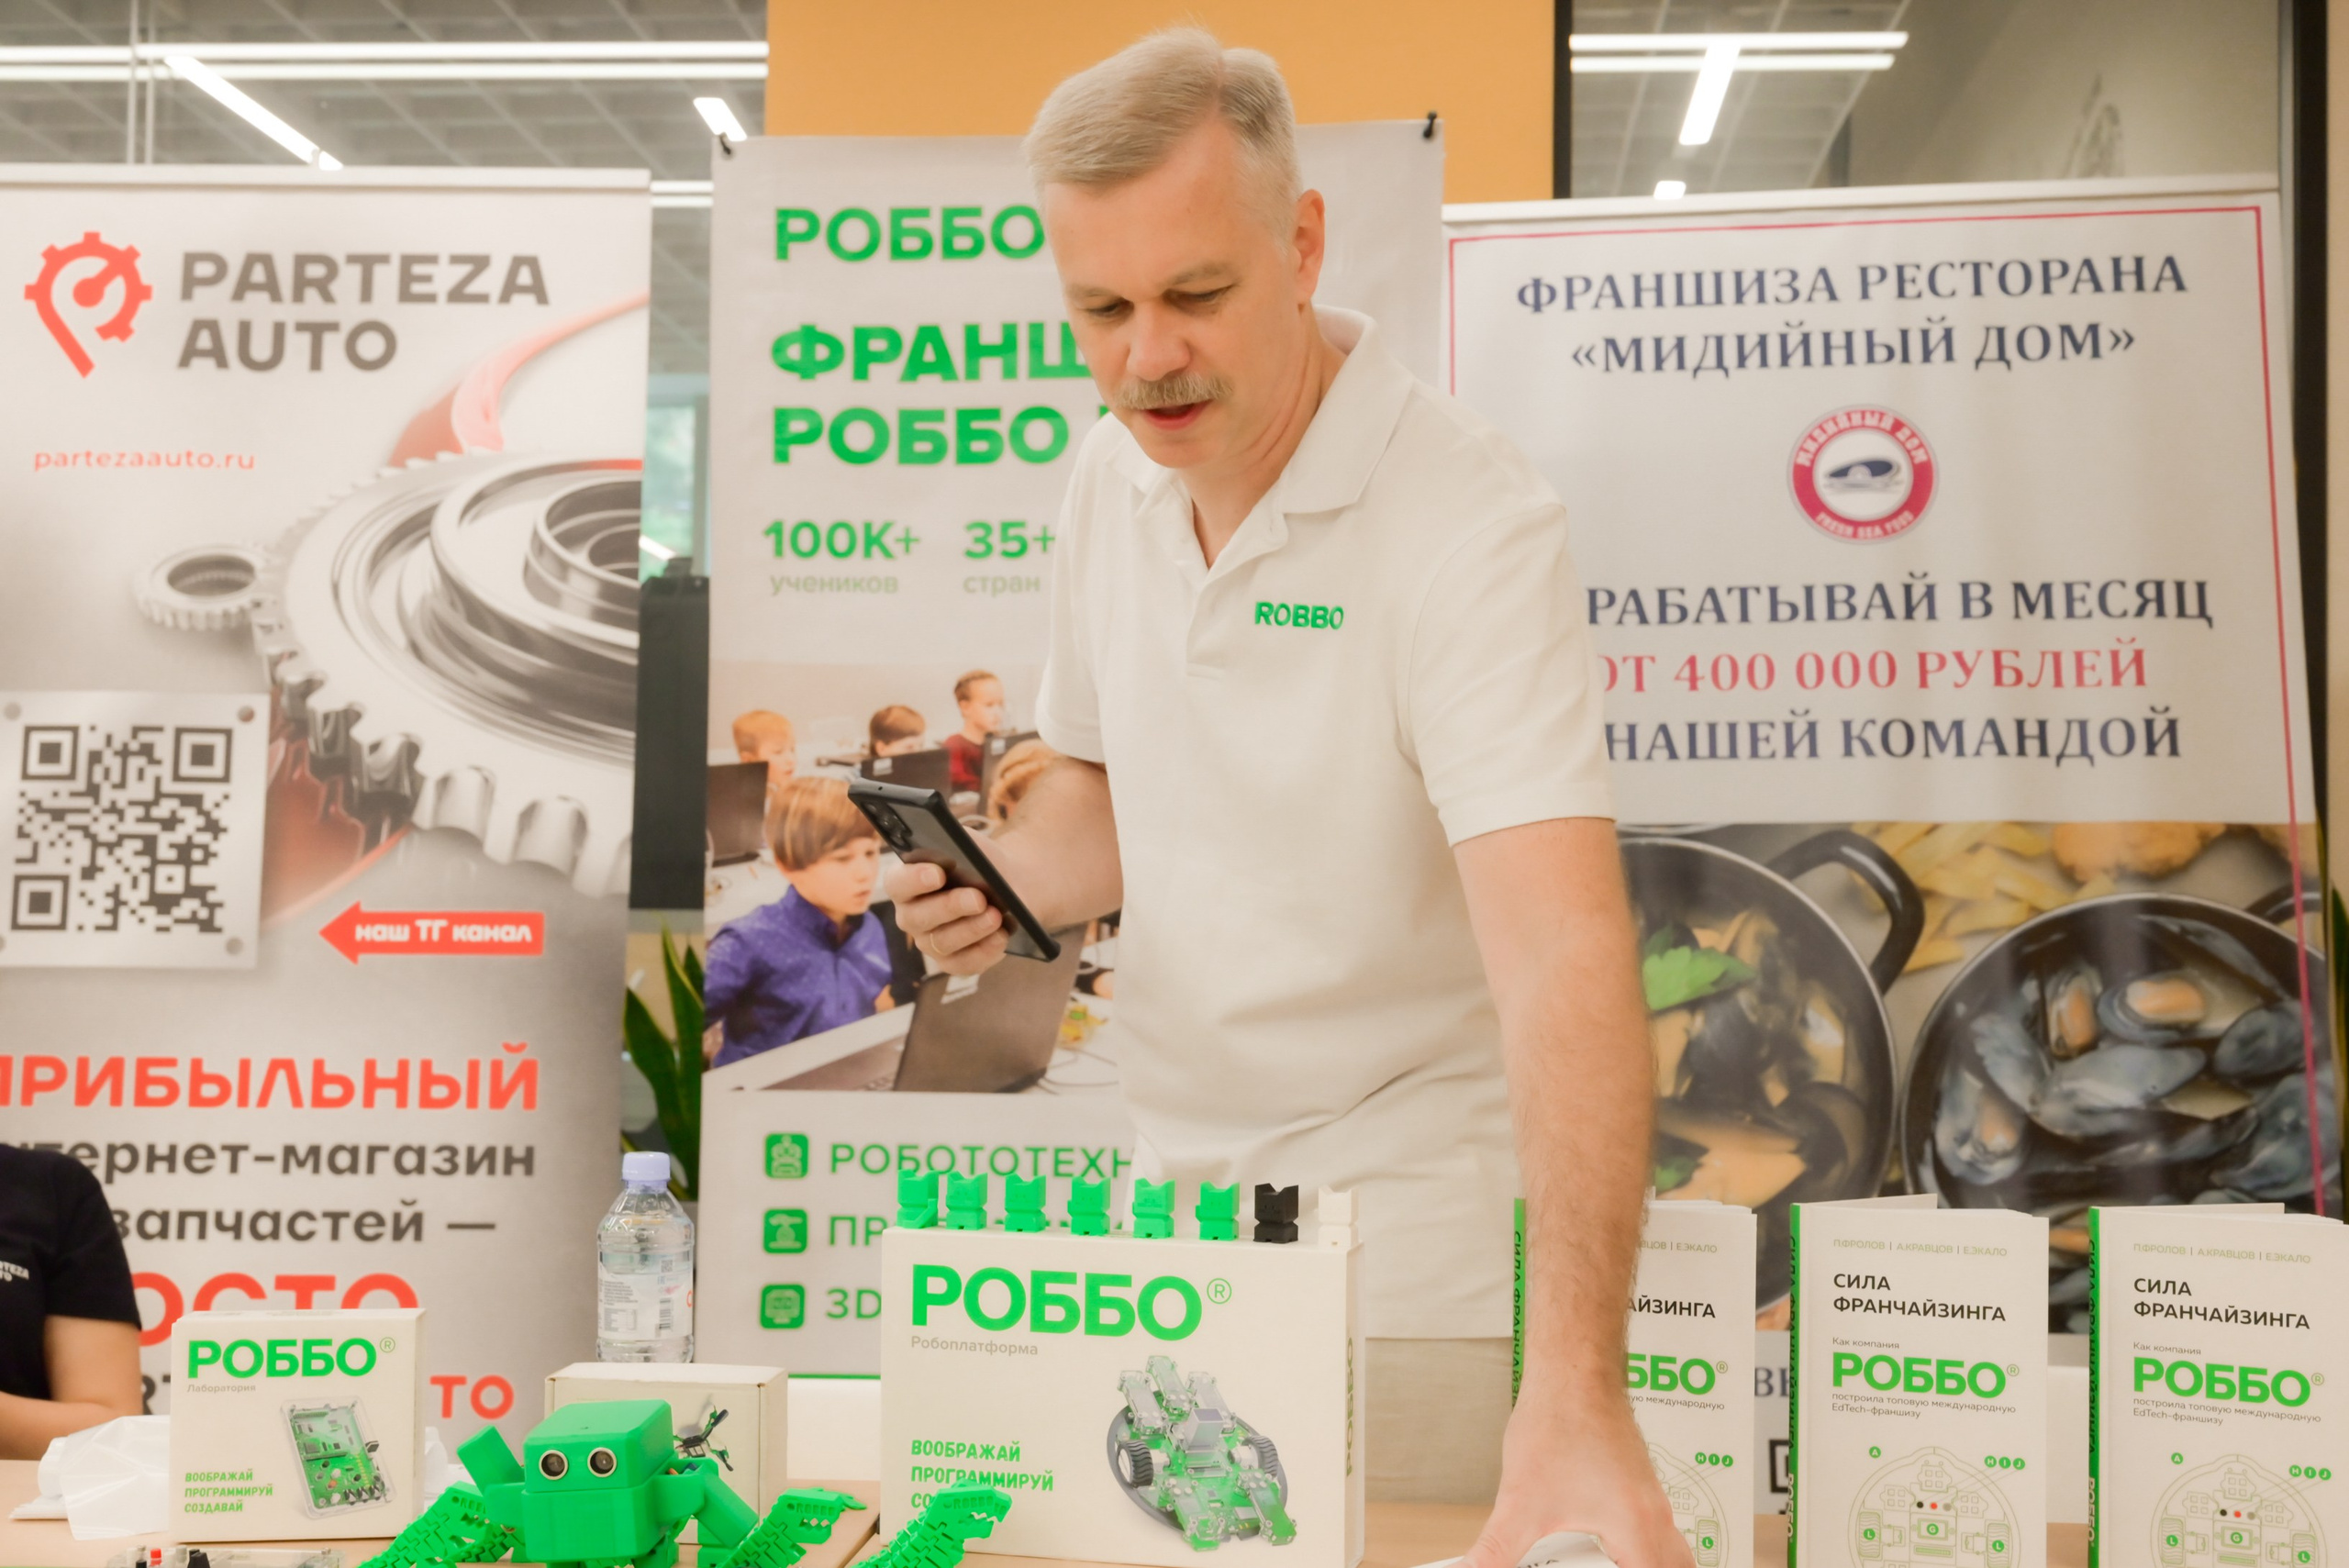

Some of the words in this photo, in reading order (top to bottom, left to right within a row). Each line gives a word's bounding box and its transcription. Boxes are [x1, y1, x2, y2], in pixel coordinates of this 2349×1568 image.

[775, 205, 1045, 262] РОББО
[180, 251, 551, 306] PARTEZA
[1516, 263, 1840, 317] ФРАНШИЗА
[1858, 253, 2189, 304] РЕСТОРАНА
[177, 318, 398, 373] AUTO
[1570, 316, 1958, 380] «МИДИЙНЫЙ
[1975, 320, 2137, 372] ДОМ»
[773, 406, 1070, 465] РОББО
[34, 449, 256, 472] partezaauto.ru
[963, 520, 1055, 559] 35+
[770, 574, 899, 596] учеников
[963, 574, 1041, 597] стран
[1254, 601, 1344, 630] ROBBO
[1960, 580, 1995, 621] В
[2011, 579, 2213, 629] МЕСЯЦ
[1674, 652, 1778, 693] 400
[1796, 650, 1899, 690] 000
[1917, 637, 2149, 690] РУБЛЕЙ
[1842, 706, 2183, 769] КОМАНДОЙ
[355, 923, 409, 942] наш
[416, 919, 448, 942] ТГ
[452, 923, 532, 943] канал
[0, 1041, 540, 1111] РИБЫЛЬНЫЙ
[1676, 1242, 1718, 1253] Е.ЭКАЛО
[1833, 1239, 1885, 1251] П.ФРОЛОВ
[1897, 1242, 1953, 1254] А.КРАВЦОВ
[1964, 1245, 2008, 1257] Е.ЭКАЛО
[2133, 1243, 2187, 1255] П.ФРОЛОВ
[2198, 1247, 2255, 1260] А.КРАВЦОВ
[2266, 1251, 2310, 1264] Е.ЭКАЛО
[1833, 1273, 1891, 1291] СИЛА
[2133, 1278, 2192, 1296] СИЛА
[1833, 1296, 2006, 1322] ФРАНЧАЙЗИНГА
[2133, 1301, 2310, 1329] ФРАНЧАЙЗИНГА
[910, 1334, 1039, 1356] Робоплатформа
[1832, 1337, 1850, 1347] Как
[1853, 1339, 1900, 1350] компания
[2133, 1341, 2151, 1352] Как
[2154, 1344, 2201, 1355] компания
[187, 1384, 256, 1394] Лаборатория
[1646, 1396, 1725, 1410] международную
[1831, 1403, 1920, 1419] EdTech-франшизу
[1832, 1393, 1884, 1407] построила
[1887, 1396, 1929, 1409] топовую
[1932, 1398, 2016, 1414] международную
[2133, 1397, 2186, 1411] построила
[2188, 1402, 2232, 1416] топовую
[2234, 1406, 2321, 1423] международную
[2132, 1407, 2224, 1426] EdTech-франшизу
[911, 1438, 1021, 1462] ВООБРАЖАЙ
[184, 1469, 253, 1483] ВООБРАЖАЙ
[910, 1465, 1054, 1493] ПРОГРАММИРУЙ
[184, 1483, 273, 1497] ПРОГРАММИРУЙ
[184, 1498, 243, 1513] СОЗДАВАЙ
